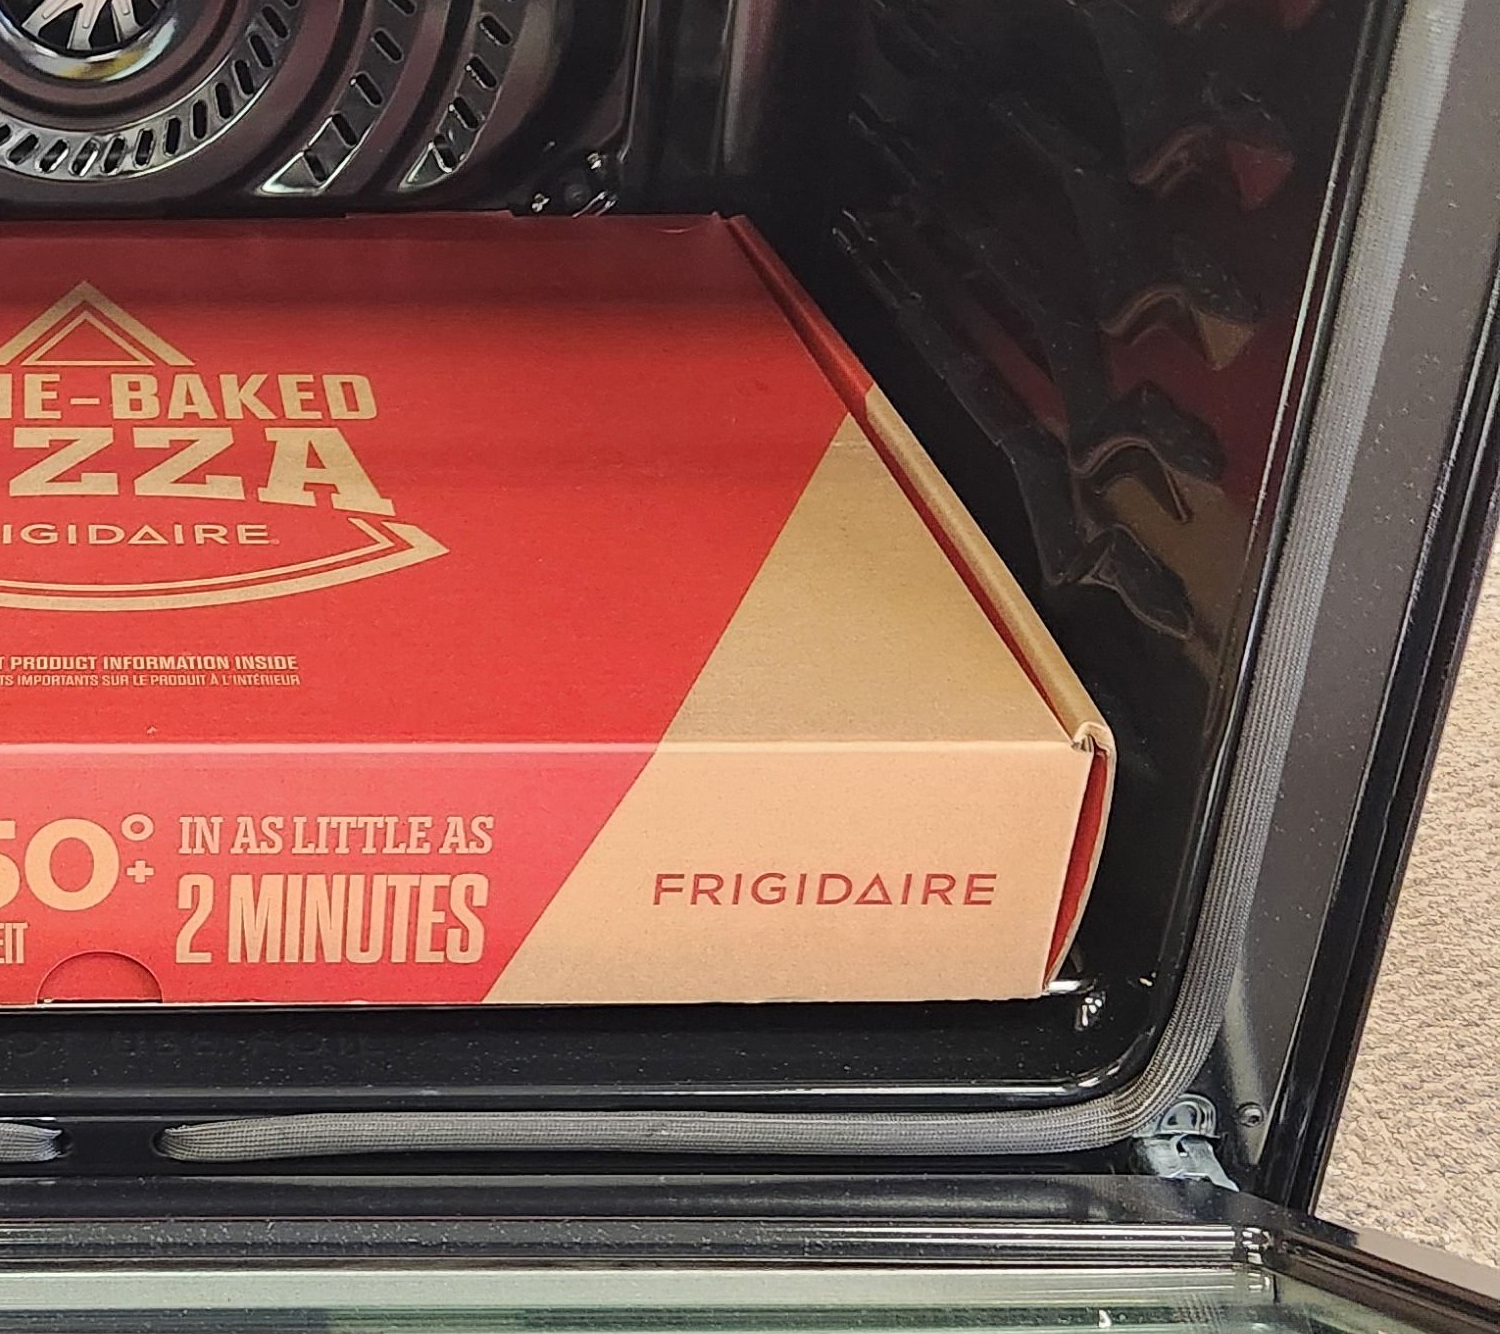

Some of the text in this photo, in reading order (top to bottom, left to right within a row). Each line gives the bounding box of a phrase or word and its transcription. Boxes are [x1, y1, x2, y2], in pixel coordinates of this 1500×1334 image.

[10, 655, 98, 670] PRODUCT
[103, 655, 230, 670] INFORMATION
[234, 655, 299, 670] INSIDE
[17, 674, 99, 686] IMPORTANTS
[101, 674, 129, 686] SUR
[132, 674, 147, 686] LE
[150, 674, 206, 686] PRODUIT
[210, 673, 220, 686] À
[178, 815, 494, 854] IN AS LITTLE AS
[653, 872, 998, 906] FRIGIDAIRE
[175, 873, 489, 964] 2 MINUTES
